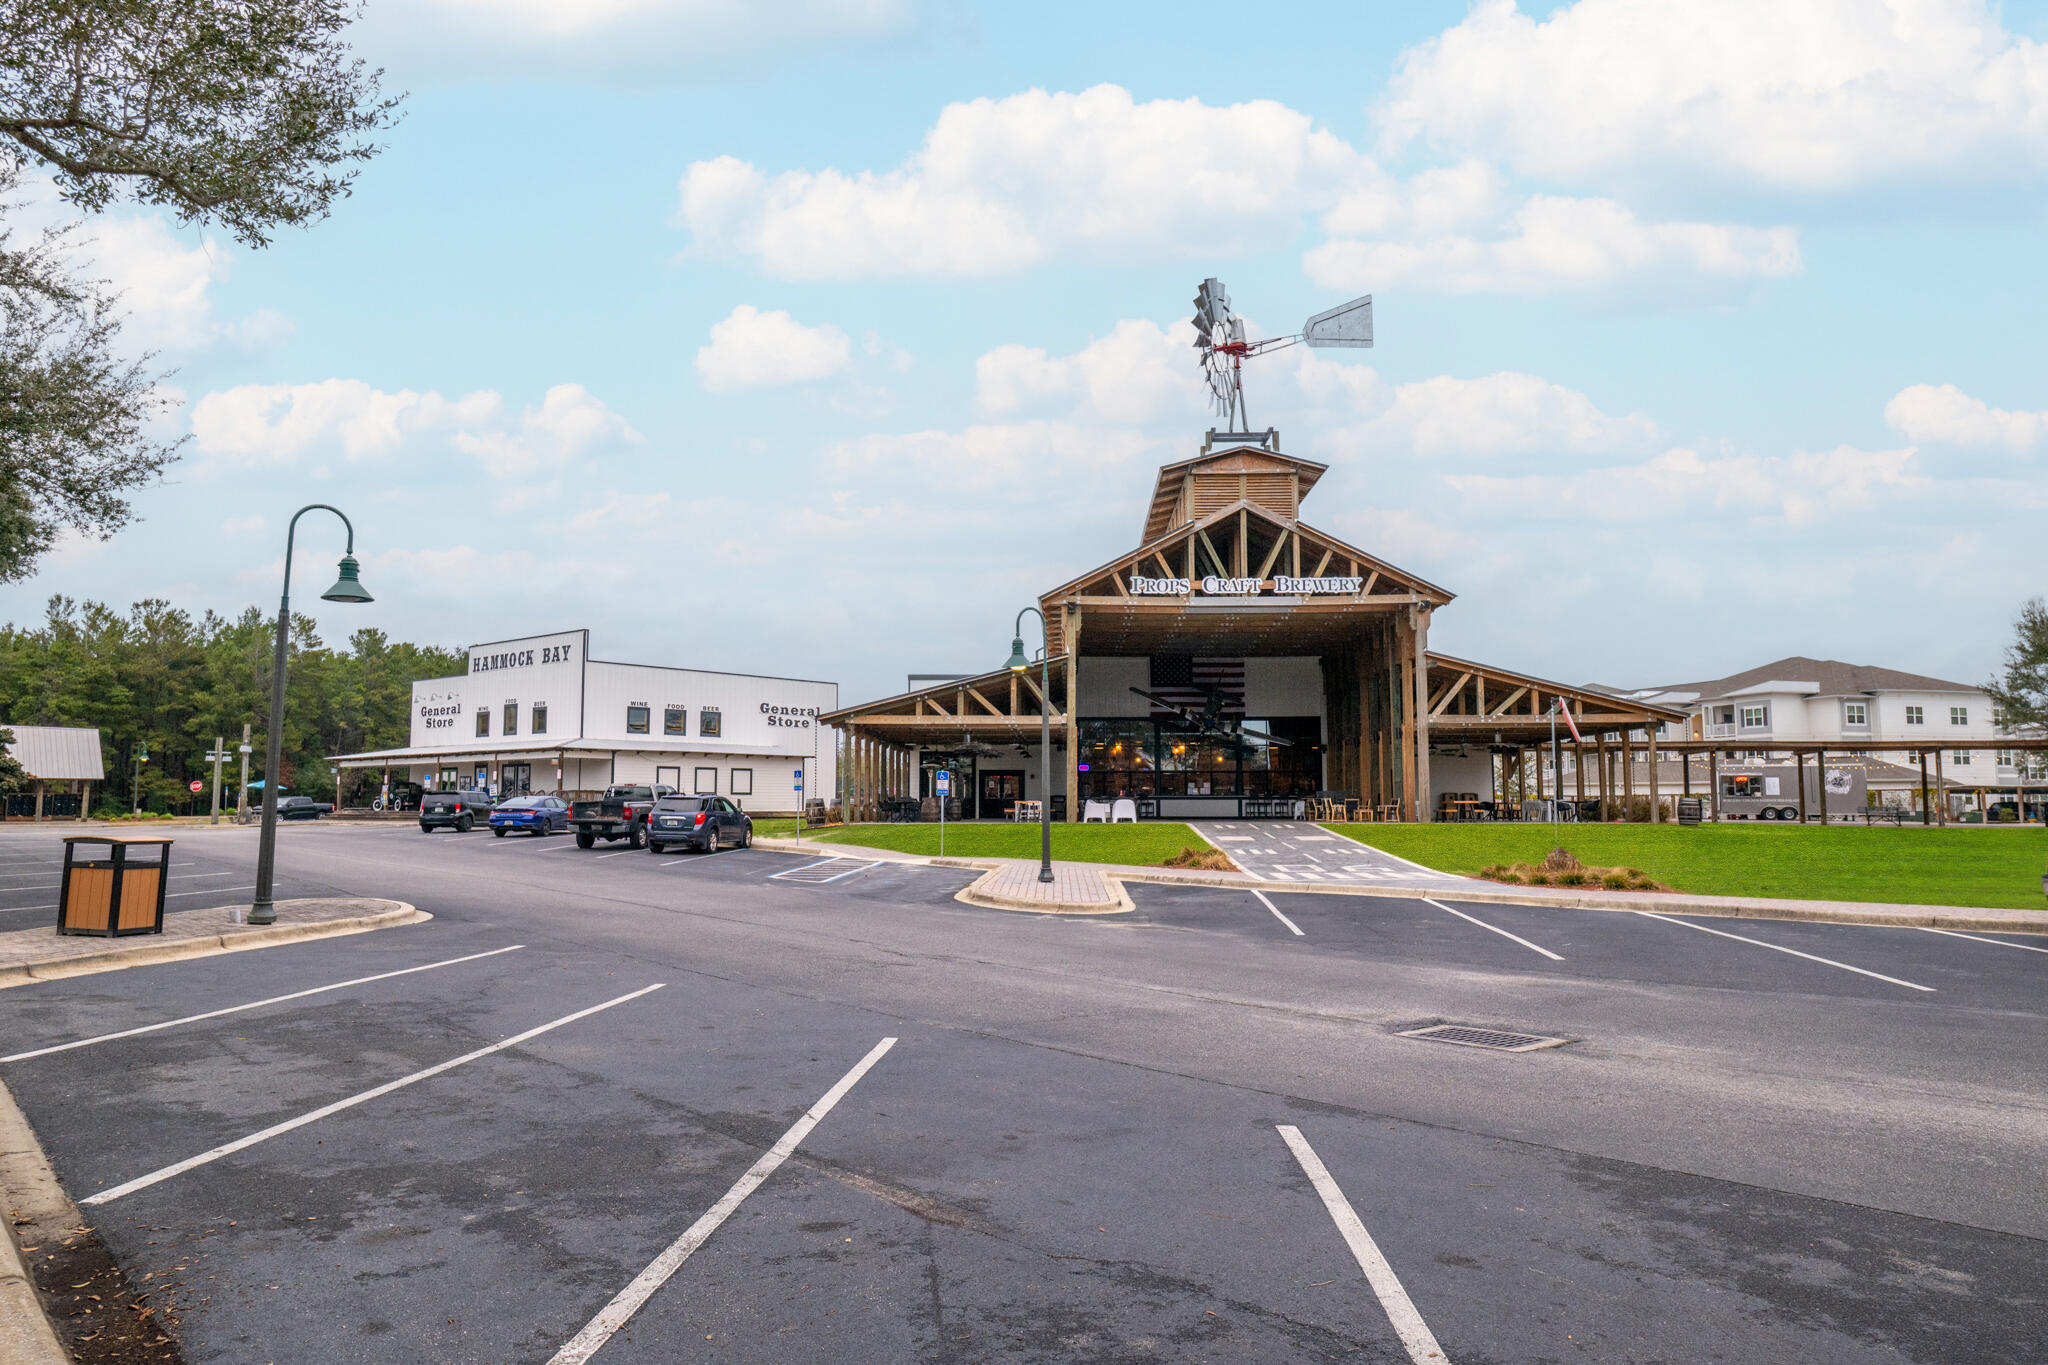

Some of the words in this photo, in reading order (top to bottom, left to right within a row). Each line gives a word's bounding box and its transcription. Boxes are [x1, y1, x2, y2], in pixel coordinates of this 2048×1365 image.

[1131, 577, 1189, 593] PROPS
[1202, 576, 1262, 593] CRAFT
[1274, 576, 1362, 593] BREWERY
[473, 650, 534, 673] HAMMOCK
[542, 645, 571, 664] BAY
[421, 704, 461, 717] General
[760, 702, 821, 717] General
[426, 717, 454, 729] Store
[767, 715, 810, 728] Store
